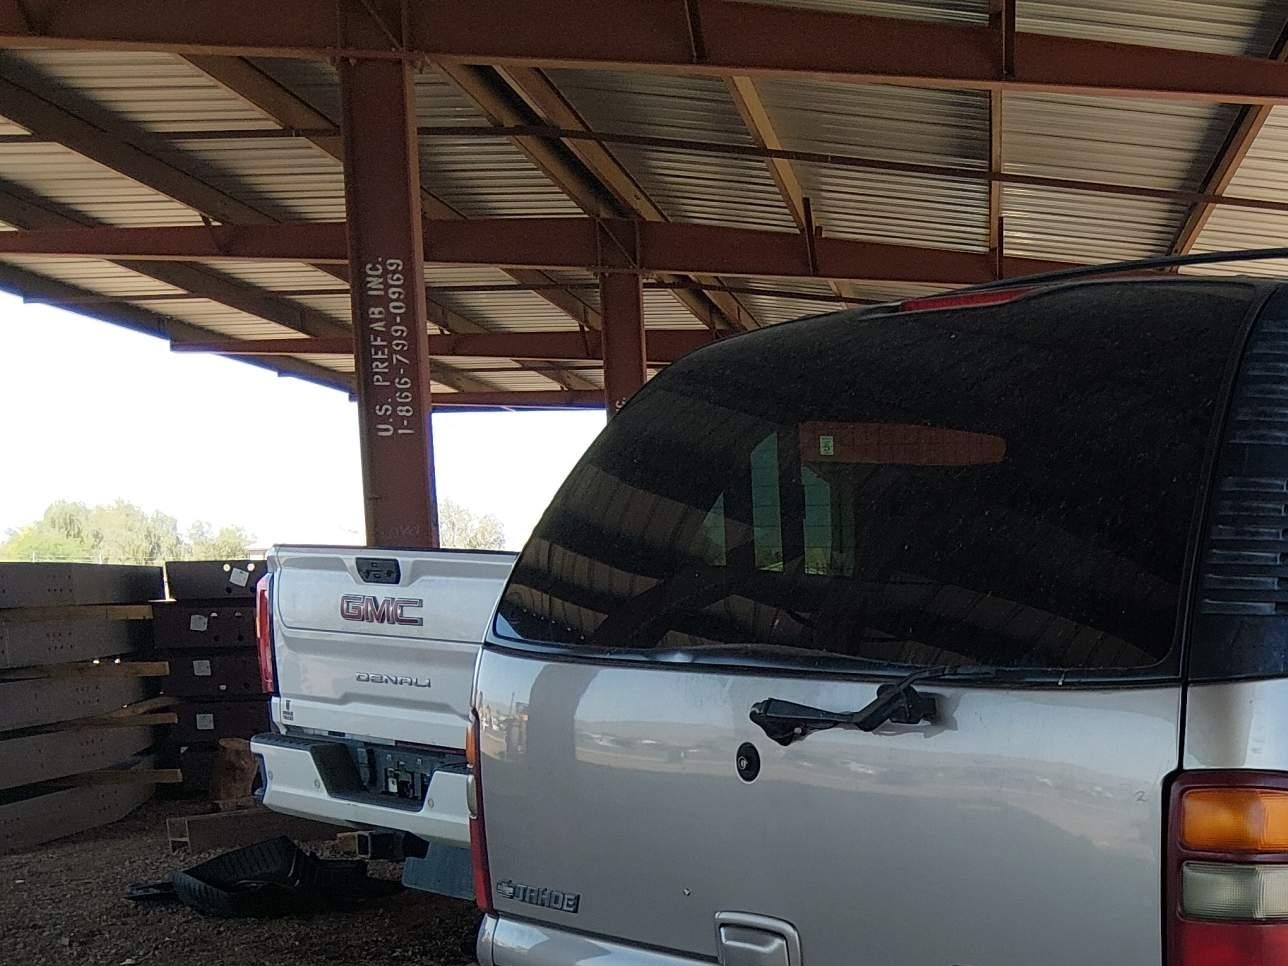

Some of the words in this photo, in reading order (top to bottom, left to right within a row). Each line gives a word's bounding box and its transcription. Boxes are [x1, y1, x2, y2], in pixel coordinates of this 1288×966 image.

[365, 257, 385, 296] INC.
[368, 307, 391, 386] PREFAB
[386, 258, 415, 435] 1-866-799-0969
[375, 398, 394, 436] U.S.
[340, 593, 424, 627] GMC
[354, 671, 432, 689] DENALI
[514, 883, 581, 914] TAHOE
